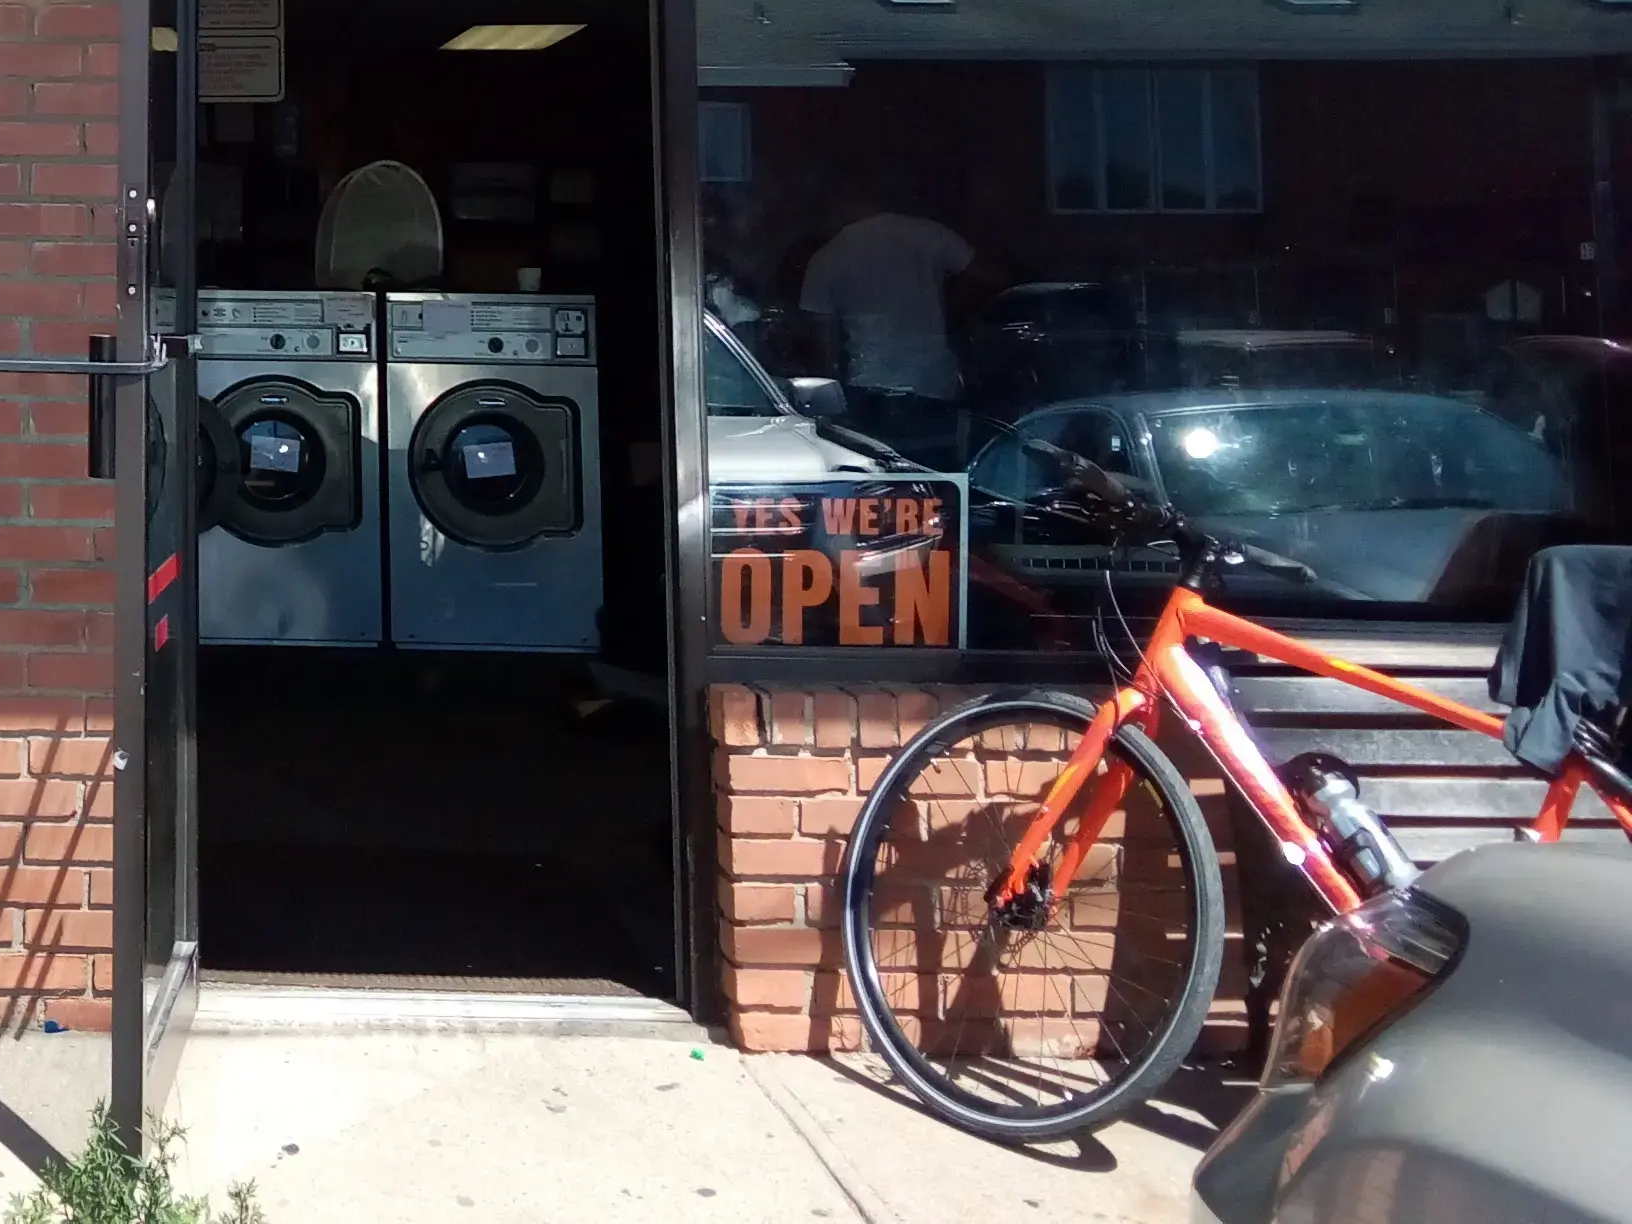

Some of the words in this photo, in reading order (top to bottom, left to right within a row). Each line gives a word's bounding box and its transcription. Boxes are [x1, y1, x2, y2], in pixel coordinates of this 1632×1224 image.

[730, 497, 803, 535] YES
[821, 496, 944, 536] WE'RE
[720, 546, 951, 646] OPEN
